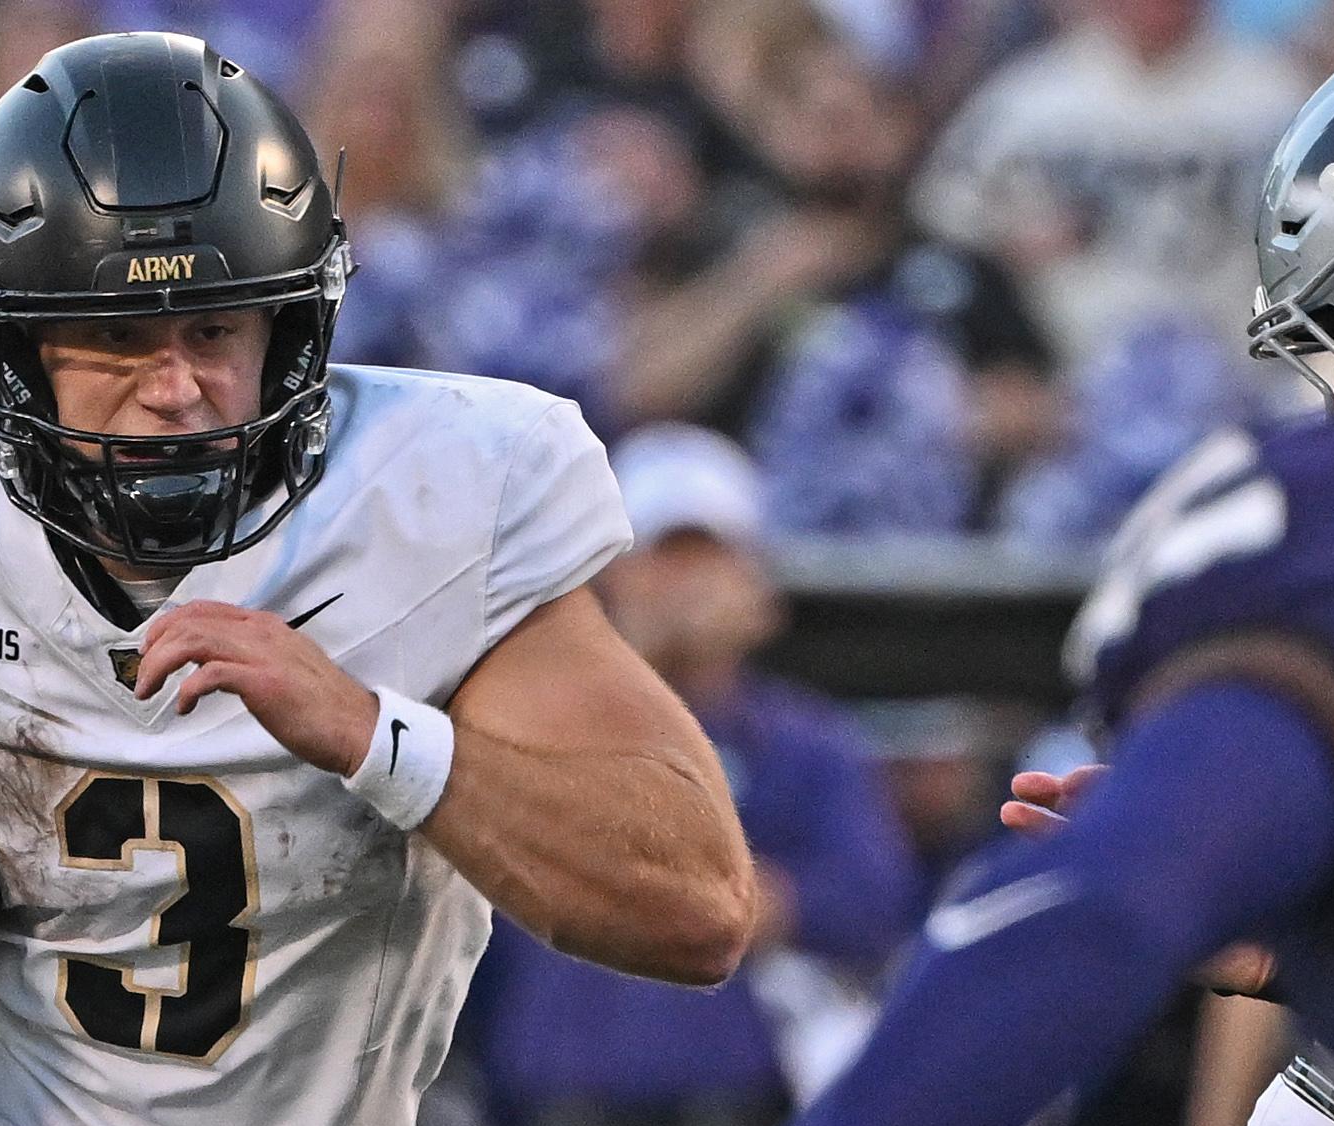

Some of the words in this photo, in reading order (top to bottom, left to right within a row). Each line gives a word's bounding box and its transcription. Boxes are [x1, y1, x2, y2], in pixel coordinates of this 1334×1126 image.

[127, 254, 196, 283] ARMY
[282, 340, 313, 391] BLAC
[55, 767, 260, 1066] 3
